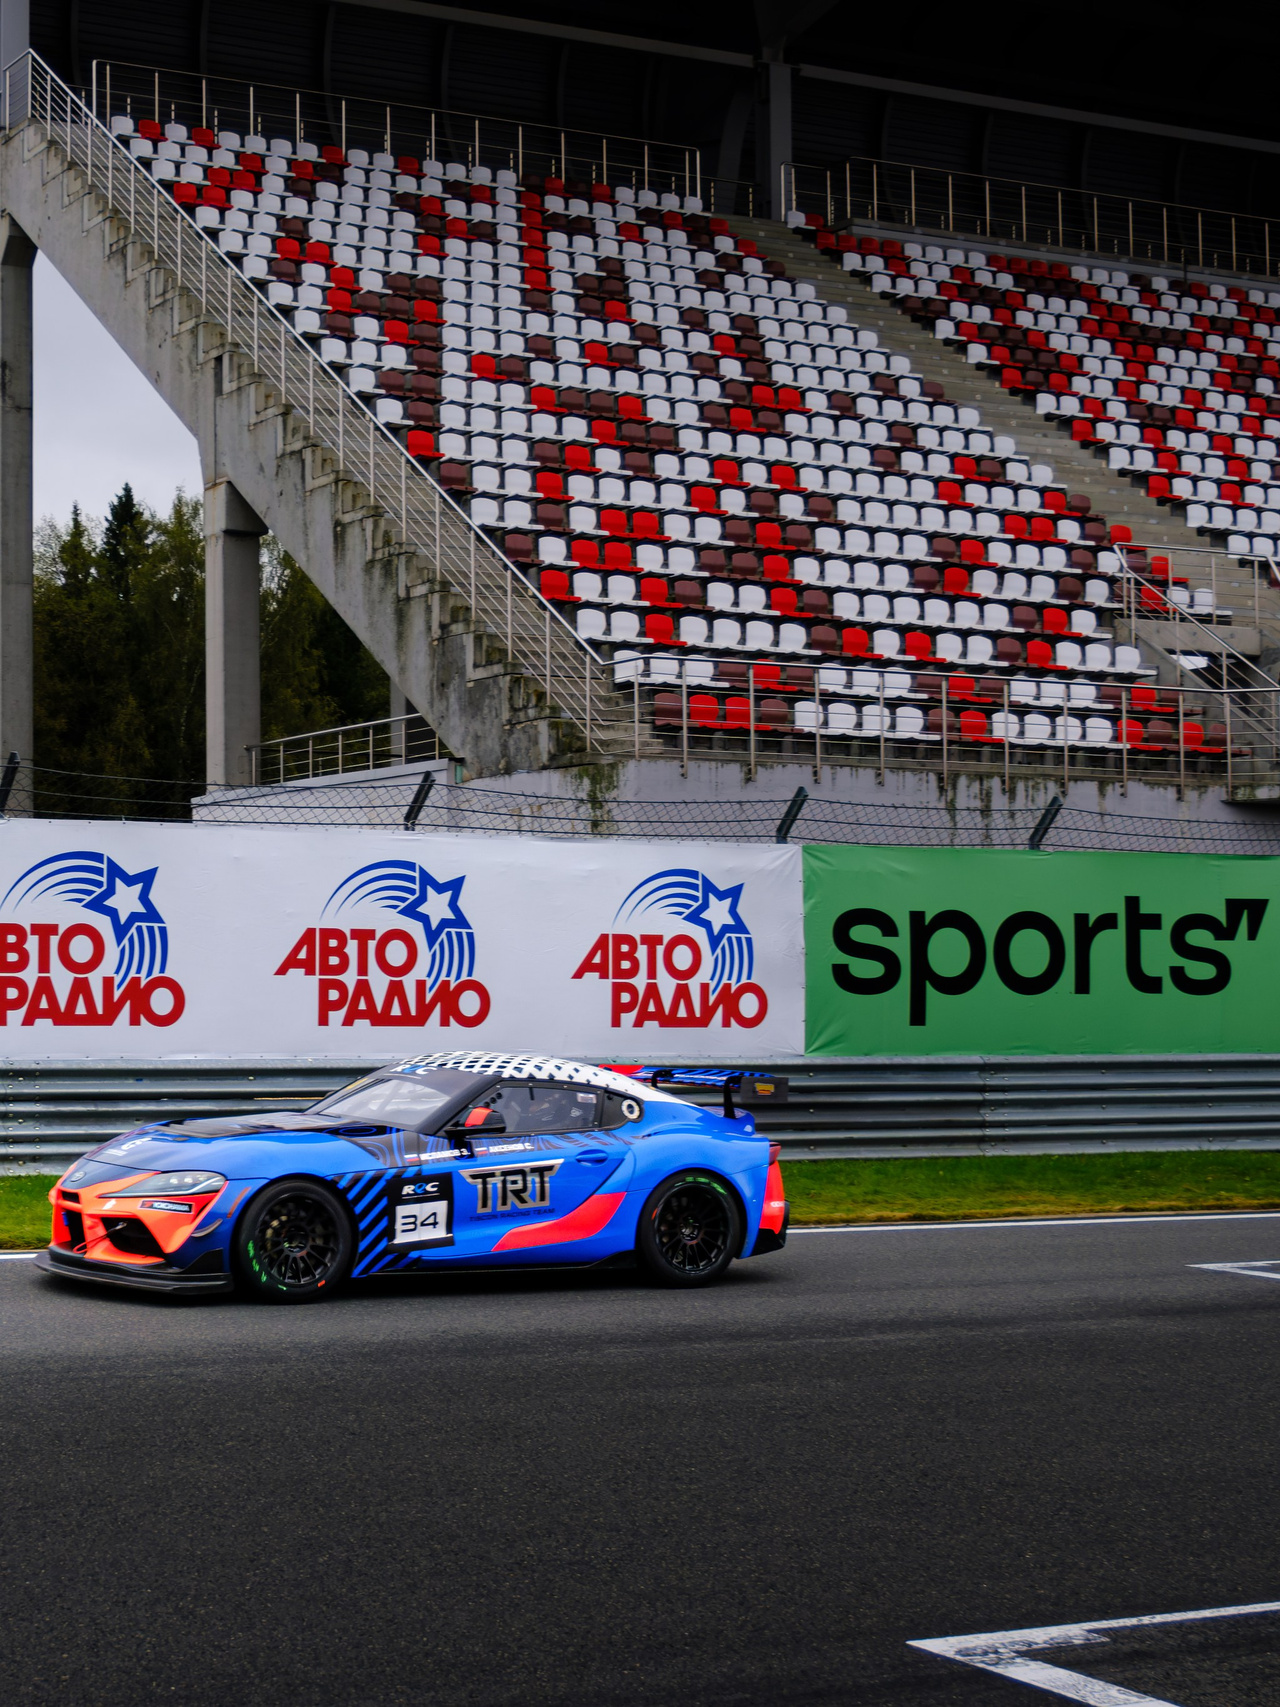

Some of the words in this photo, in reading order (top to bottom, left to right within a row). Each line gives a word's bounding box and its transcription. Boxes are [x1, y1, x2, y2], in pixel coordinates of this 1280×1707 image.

[274, 927, 418, 978] АВТО
[571, 933, 702, 981] АВТО
[318, 978, 491, 1028] РАДИО
[611, 981, 768, 1029] РАДИО
[462, 1162, 561, 1213] TRT
[533, 1207, 556, 1215] TEAM
[401, 1211, 439, 1233] 34
